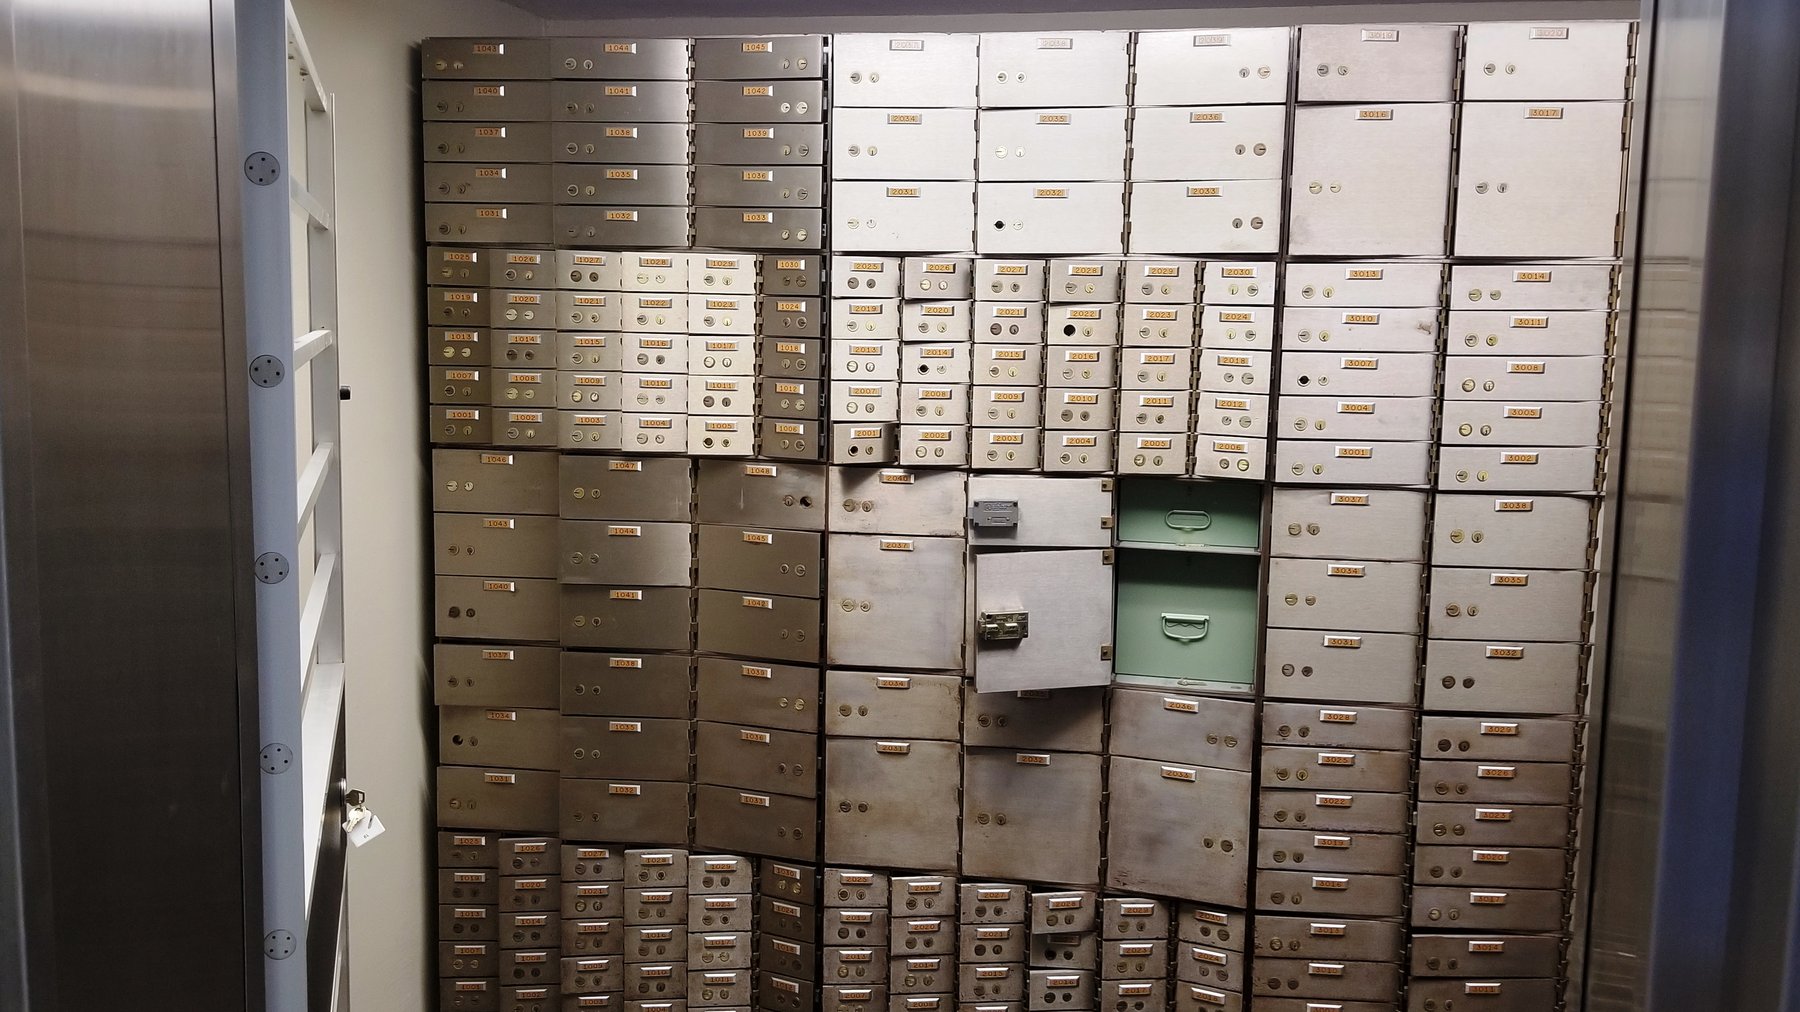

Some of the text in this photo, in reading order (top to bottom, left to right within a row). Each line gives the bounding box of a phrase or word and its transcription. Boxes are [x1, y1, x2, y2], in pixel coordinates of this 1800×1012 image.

[747, 87, 766, 95] 1042
[1532, 109, 1557, 117] 3017
[479, 128, 499, 136] 1037
[479, 169, 499, 177] 1034
[1040, 189, 1062, 197] 2032
[480, 209, 500, 217] 1031
[449, 253, 470, 261] 1025
[513, 255, 535, 263] 1026
[579, 256, 600, 264] 1027
[1352, 270, 1376, 278] 3013
[1522, 272, 1546, 280] 3014
[513, 295, 535, 303] 1020
[1149, 311, 1171, 319] 2023
[514, 335, 535, 343] 1014
[780, 344, 799, 352] 1018
[855, 346, 877, 354] 2013
[1223, 357, 1246, 365] 2018
[925, 390, 946, 398] 2008
[1220, 400, 1243, 408] 2012
[1344, 404, 1368, 412] 3004
[1511, 409, 1536, 417] 3005
[645, 419, 666, 427] 1004
[1508, 454, 1532, 462] 3002
[750, 467, 770, 475] 1048
[1502, 502, 1527, 510] 3038
[614, 527, 635, 535] 1044
[747, 534, 766, 542] 1045
[1498, 576, 1522, 584] 3035
[488, 582, 509, 590] 1040
[747, 599, 766, 607] 1042
[1331, 638, 1354, 646] 3031
[488, 651, 508, 659] 1037
[1493, 649, 1517, 657] 3032
[1169, 702, 1193, 711] 2036
[1167, 771, 1189, 779] 2033
